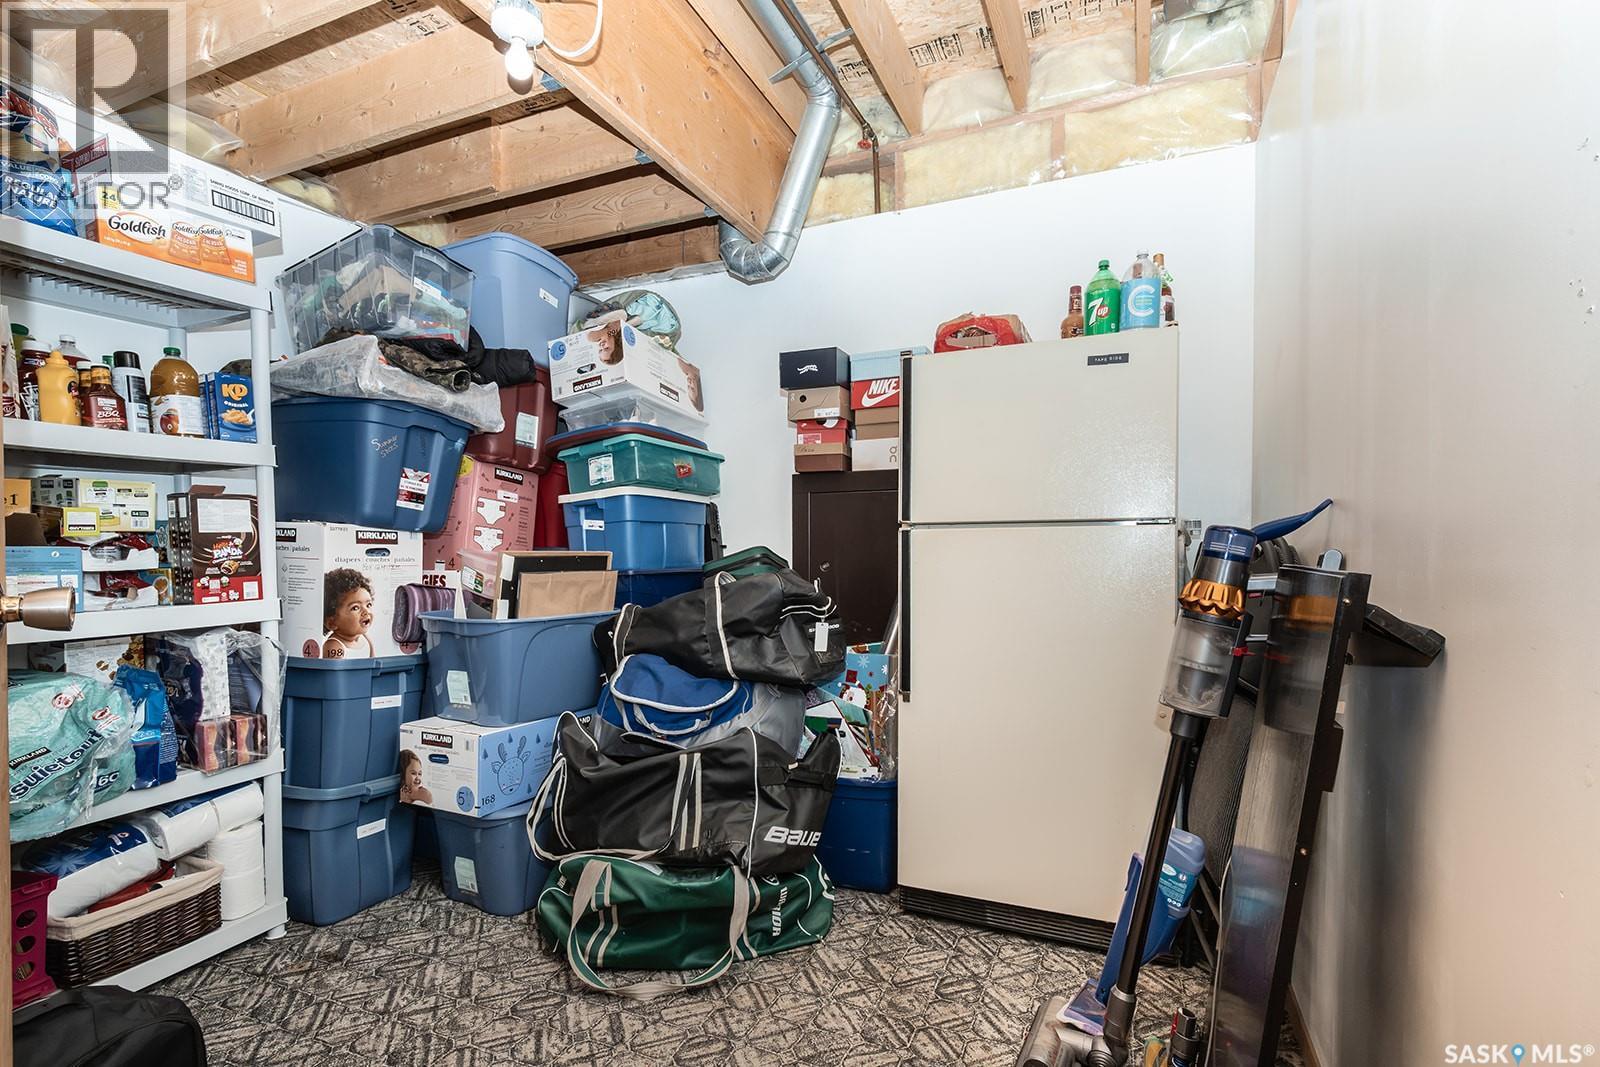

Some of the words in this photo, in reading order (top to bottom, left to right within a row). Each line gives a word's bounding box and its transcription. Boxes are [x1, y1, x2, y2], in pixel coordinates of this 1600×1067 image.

[7, 184, 57, 208] NATURE
[108, 215, 166, 240] Goldfish
[868, 378, 899, 395] NIKE
[495, 469, 523, 481] KIRKLAND
[358, 531, 397, 540] KIRKLAND
[212, 546, 244, 560] PANDA
[448, 558, 456, 568] 4
[303, 645, 312, 657] 4
[422, 733, 452, 744] KIRKLAND
[9, 747, 48, 767] KIRKLAND
[456, 792, 465, 806] 5
[481, 794, 497, 806] 168
